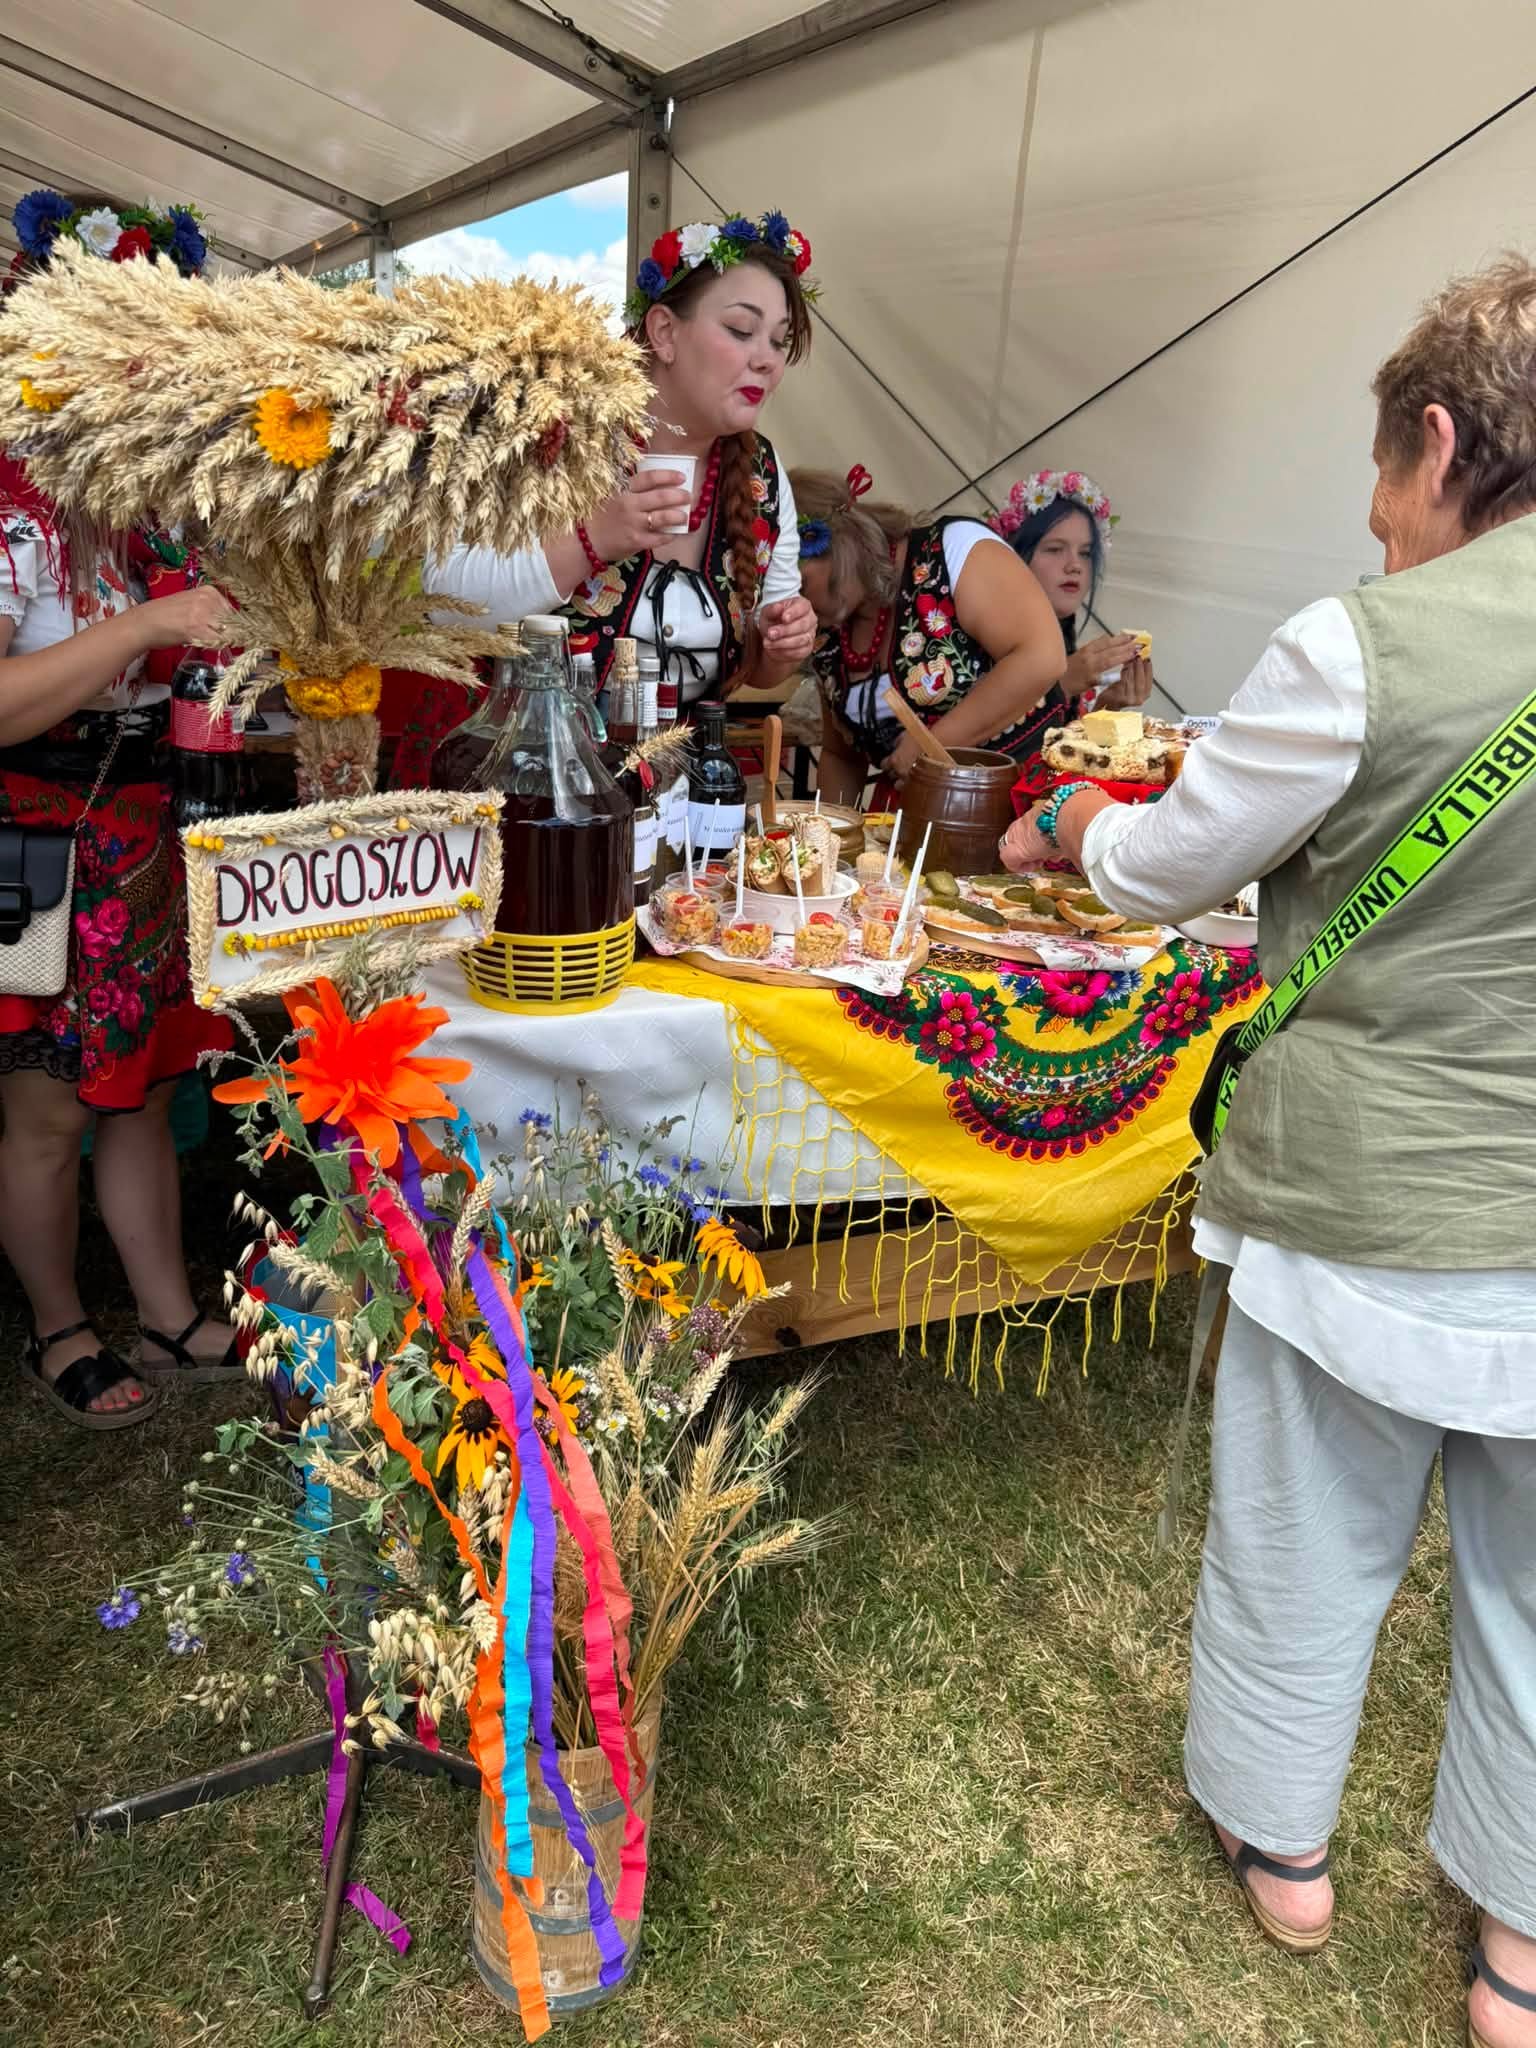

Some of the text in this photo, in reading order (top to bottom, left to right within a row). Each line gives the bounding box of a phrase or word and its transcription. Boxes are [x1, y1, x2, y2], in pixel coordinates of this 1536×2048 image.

[216, 826, 481, 927] DROGOSZOW
[1290, 712, 1536, 990] IBELLA UNIBELLA
